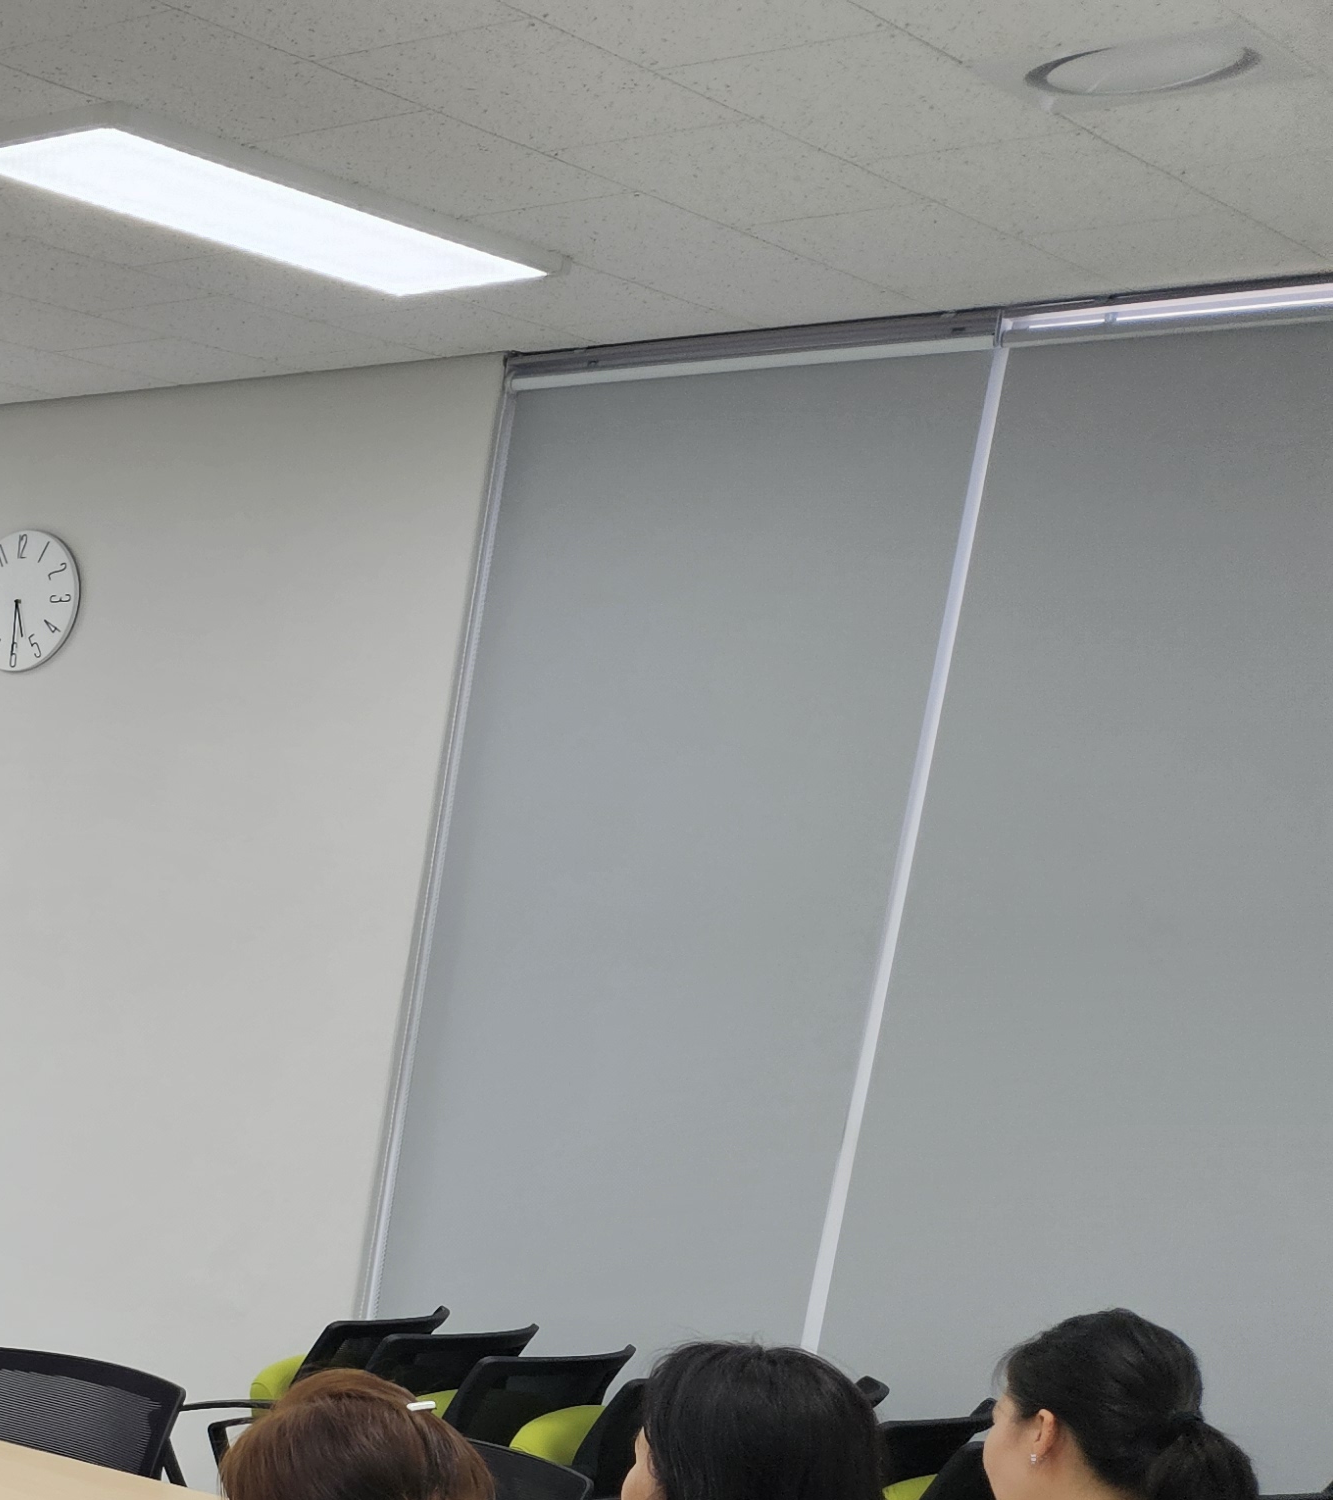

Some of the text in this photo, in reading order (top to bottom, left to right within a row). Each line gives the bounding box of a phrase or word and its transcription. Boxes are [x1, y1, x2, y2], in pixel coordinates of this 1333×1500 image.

[17, 533, 28, 559] 12
[48, 562, 67, 581] 2
[49, 593, 71, 604] 3
[44, 619, 61, 634] 4
[28, 633, 42, 659] 5
